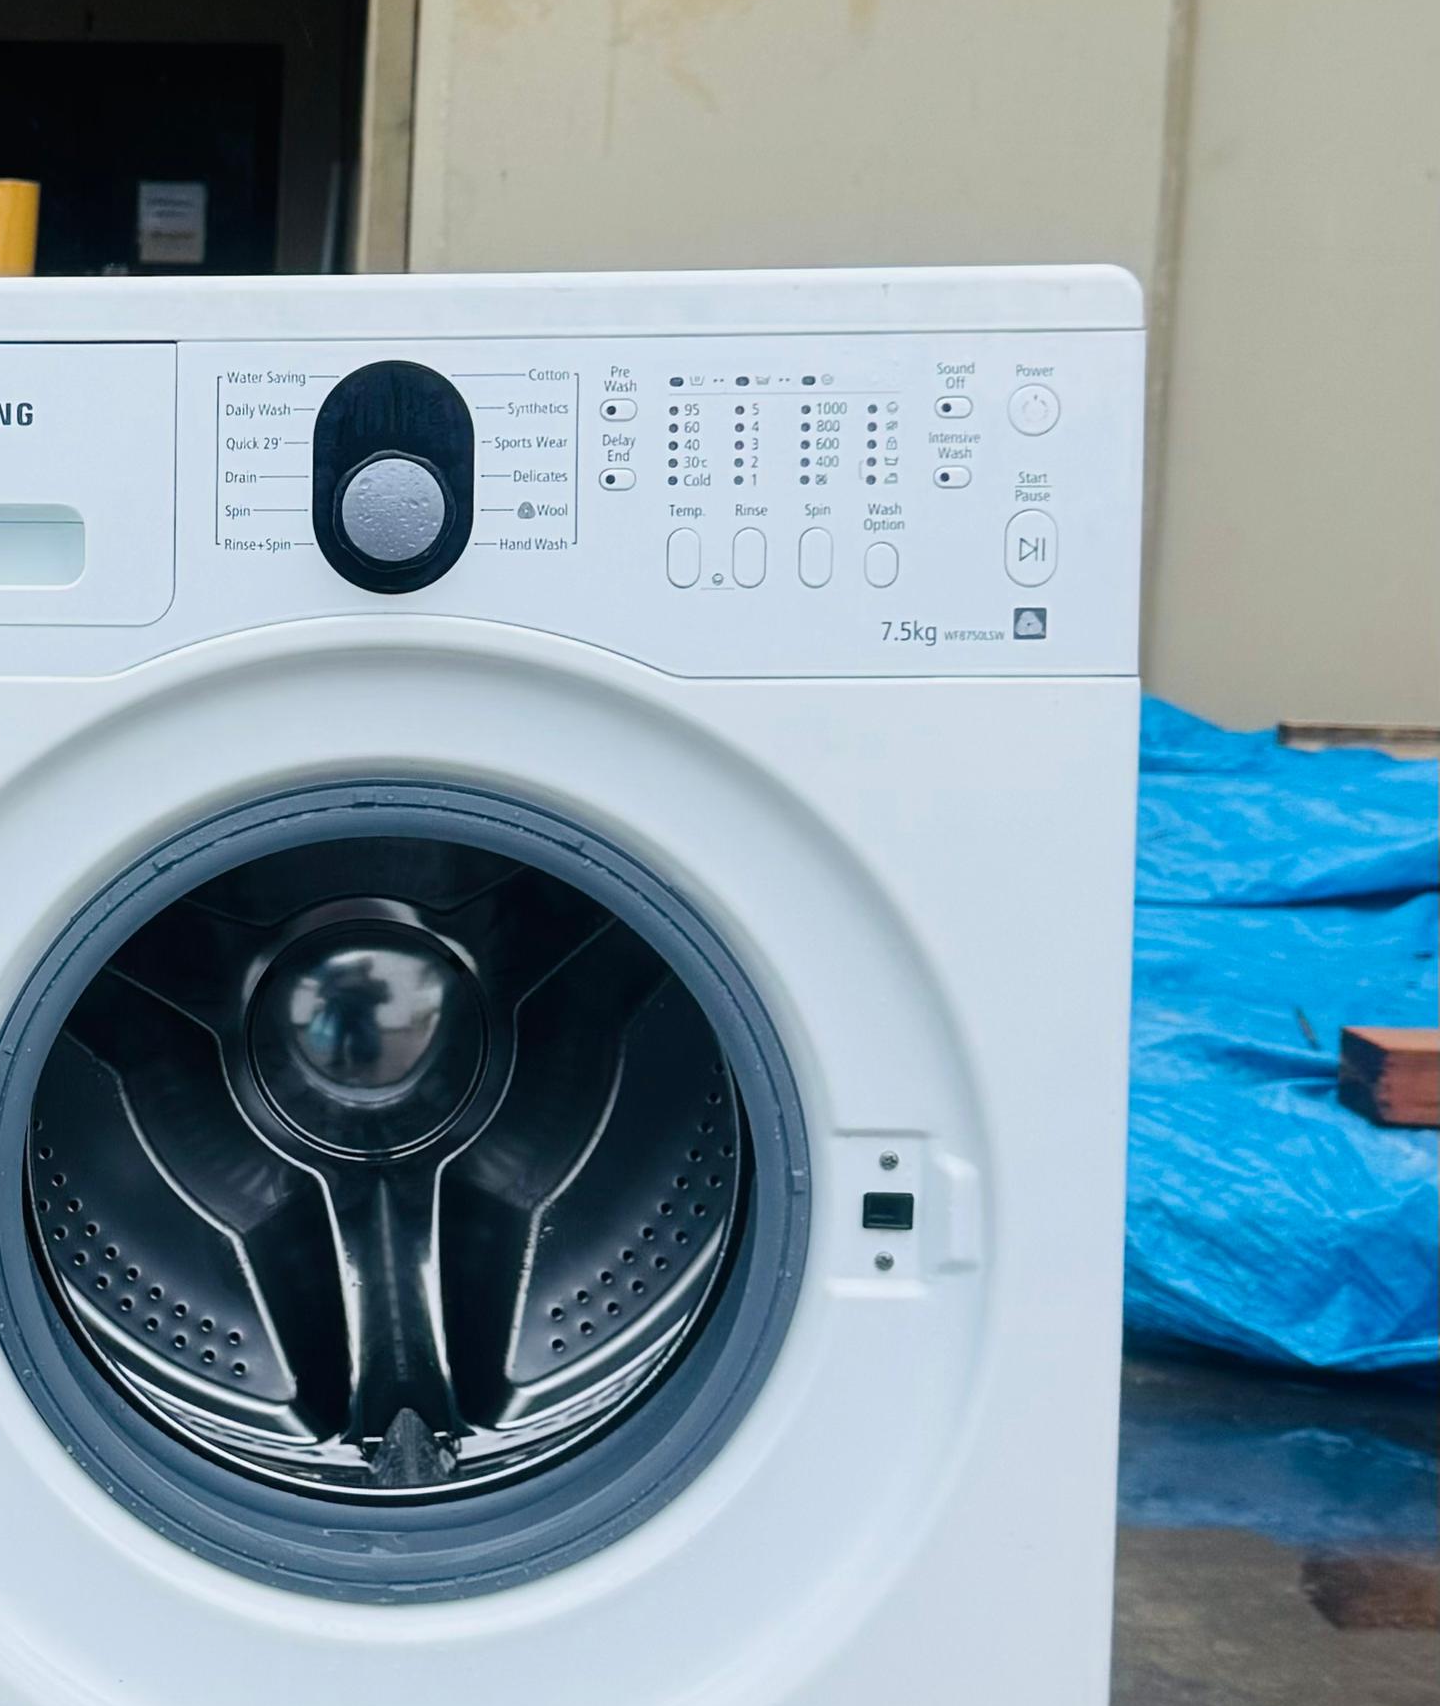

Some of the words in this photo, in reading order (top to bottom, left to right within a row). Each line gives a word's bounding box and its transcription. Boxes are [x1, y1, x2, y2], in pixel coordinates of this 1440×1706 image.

[528, 368, 570, 381] Cotton
[610, 366, 631, 379] Pre
[936, 362, 975, 375] Sound
[1015, 364, 1054, 377] Power
[226, 371, 262, 384] Water
[266, 371, 306, 386] Saving
[945, 376, 966, 389] Off
[604, 379, 637, 392] Wash
[225, 403, 255, 417] Daily
[258, 403, 291, 416] Wash
[507, 401, 569, 416] Synthetics
[684, 404, 700, 416] 95
[751, 404, 760, 415] 5
[816, 403, 848, 415] 1000
[684, 421, 700, 433] 60
[751, 421, 760, 433] 4
[816, 420, 840, 432] 800
[225, 436, 259, 451] Quick
[494, 435, 531, 450] Sports
[535, 435, 568, 448] Wear
[602, 433, 636, 450] Delay
[815, 438, 840, 450] 600
[928, 431, 981, 444] Intensive
[683, 439, 700, 451] 40
[751, 438, 759, 451] 3
[606, 450, 630, 463] End
[937, 445, 973, 459] Wash
[750, 456, 759, 468] 2
[815, 455, 840, 468] 400
[225, 470, 257, 483] Drain
[513, 469, 568, 482] Delicates
[683, 474, 711, 487] Cold
[1017, 470, 1048, 485] Start
[1014, 488, 1051, 503] Pause
[225, 504, 251, 519] Spin
[537, 503, 568, 516] Wool
[668, 504, 706, 518] Temp.
[735, 503, 768, 516] Rinse
[804, 503, 831, 519] Spin
[867, 502, 902, 516] Wash
[863, 518, 905, 532] Option
[499, 537, 530, 550] Hand
[532, 537, 568, 550] Wash
[881, 621, 937, 646] 7.5kg
